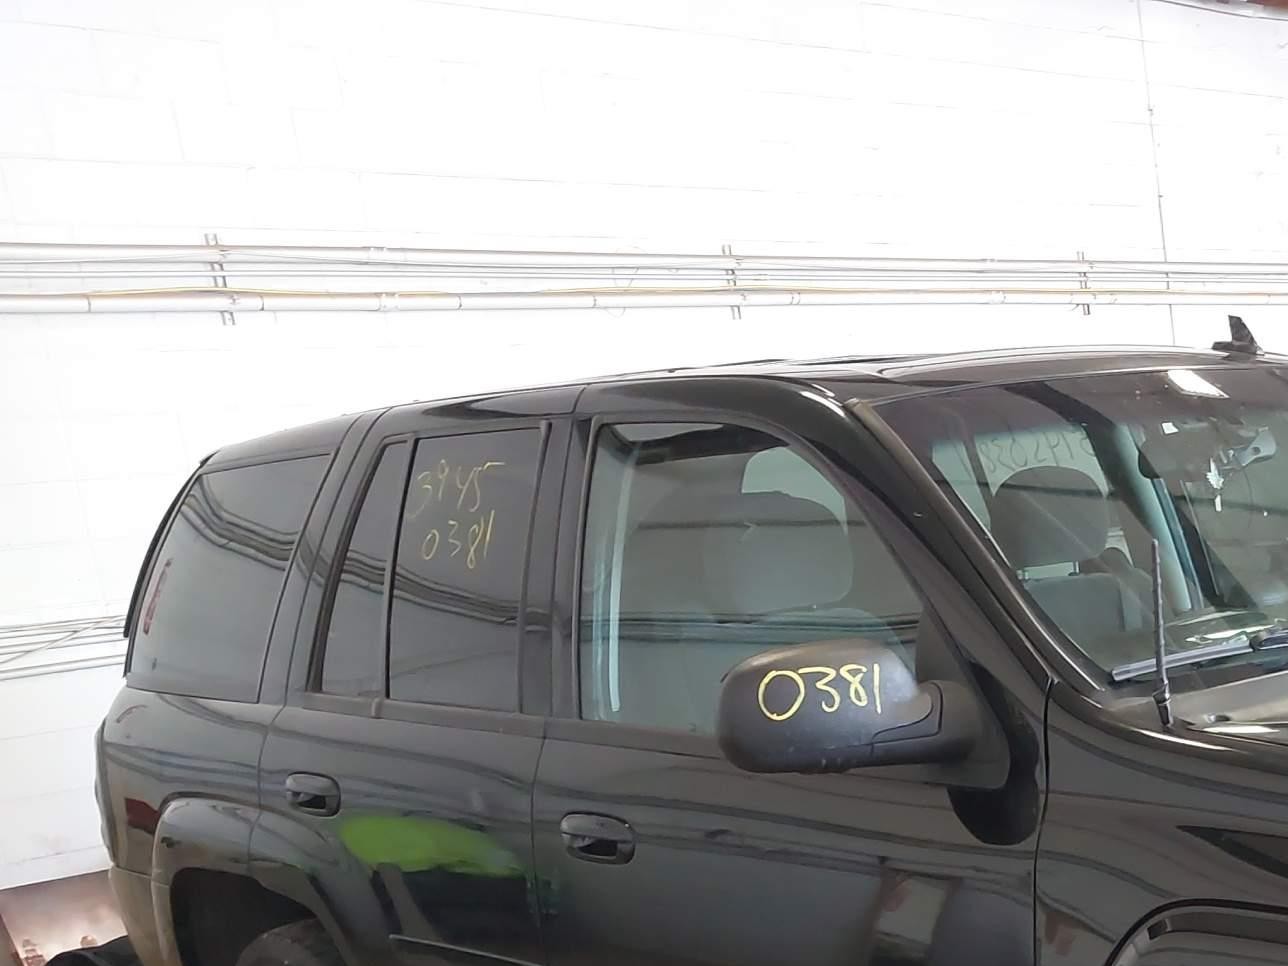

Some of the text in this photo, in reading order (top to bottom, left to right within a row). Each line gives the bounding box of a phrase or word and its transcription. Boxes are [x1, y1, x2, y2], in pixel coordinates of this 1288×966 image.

[406, 459, 505, 519] 3945
[421, 510, 496, 569] 0381
[757, 662, 883, 721] 0381
